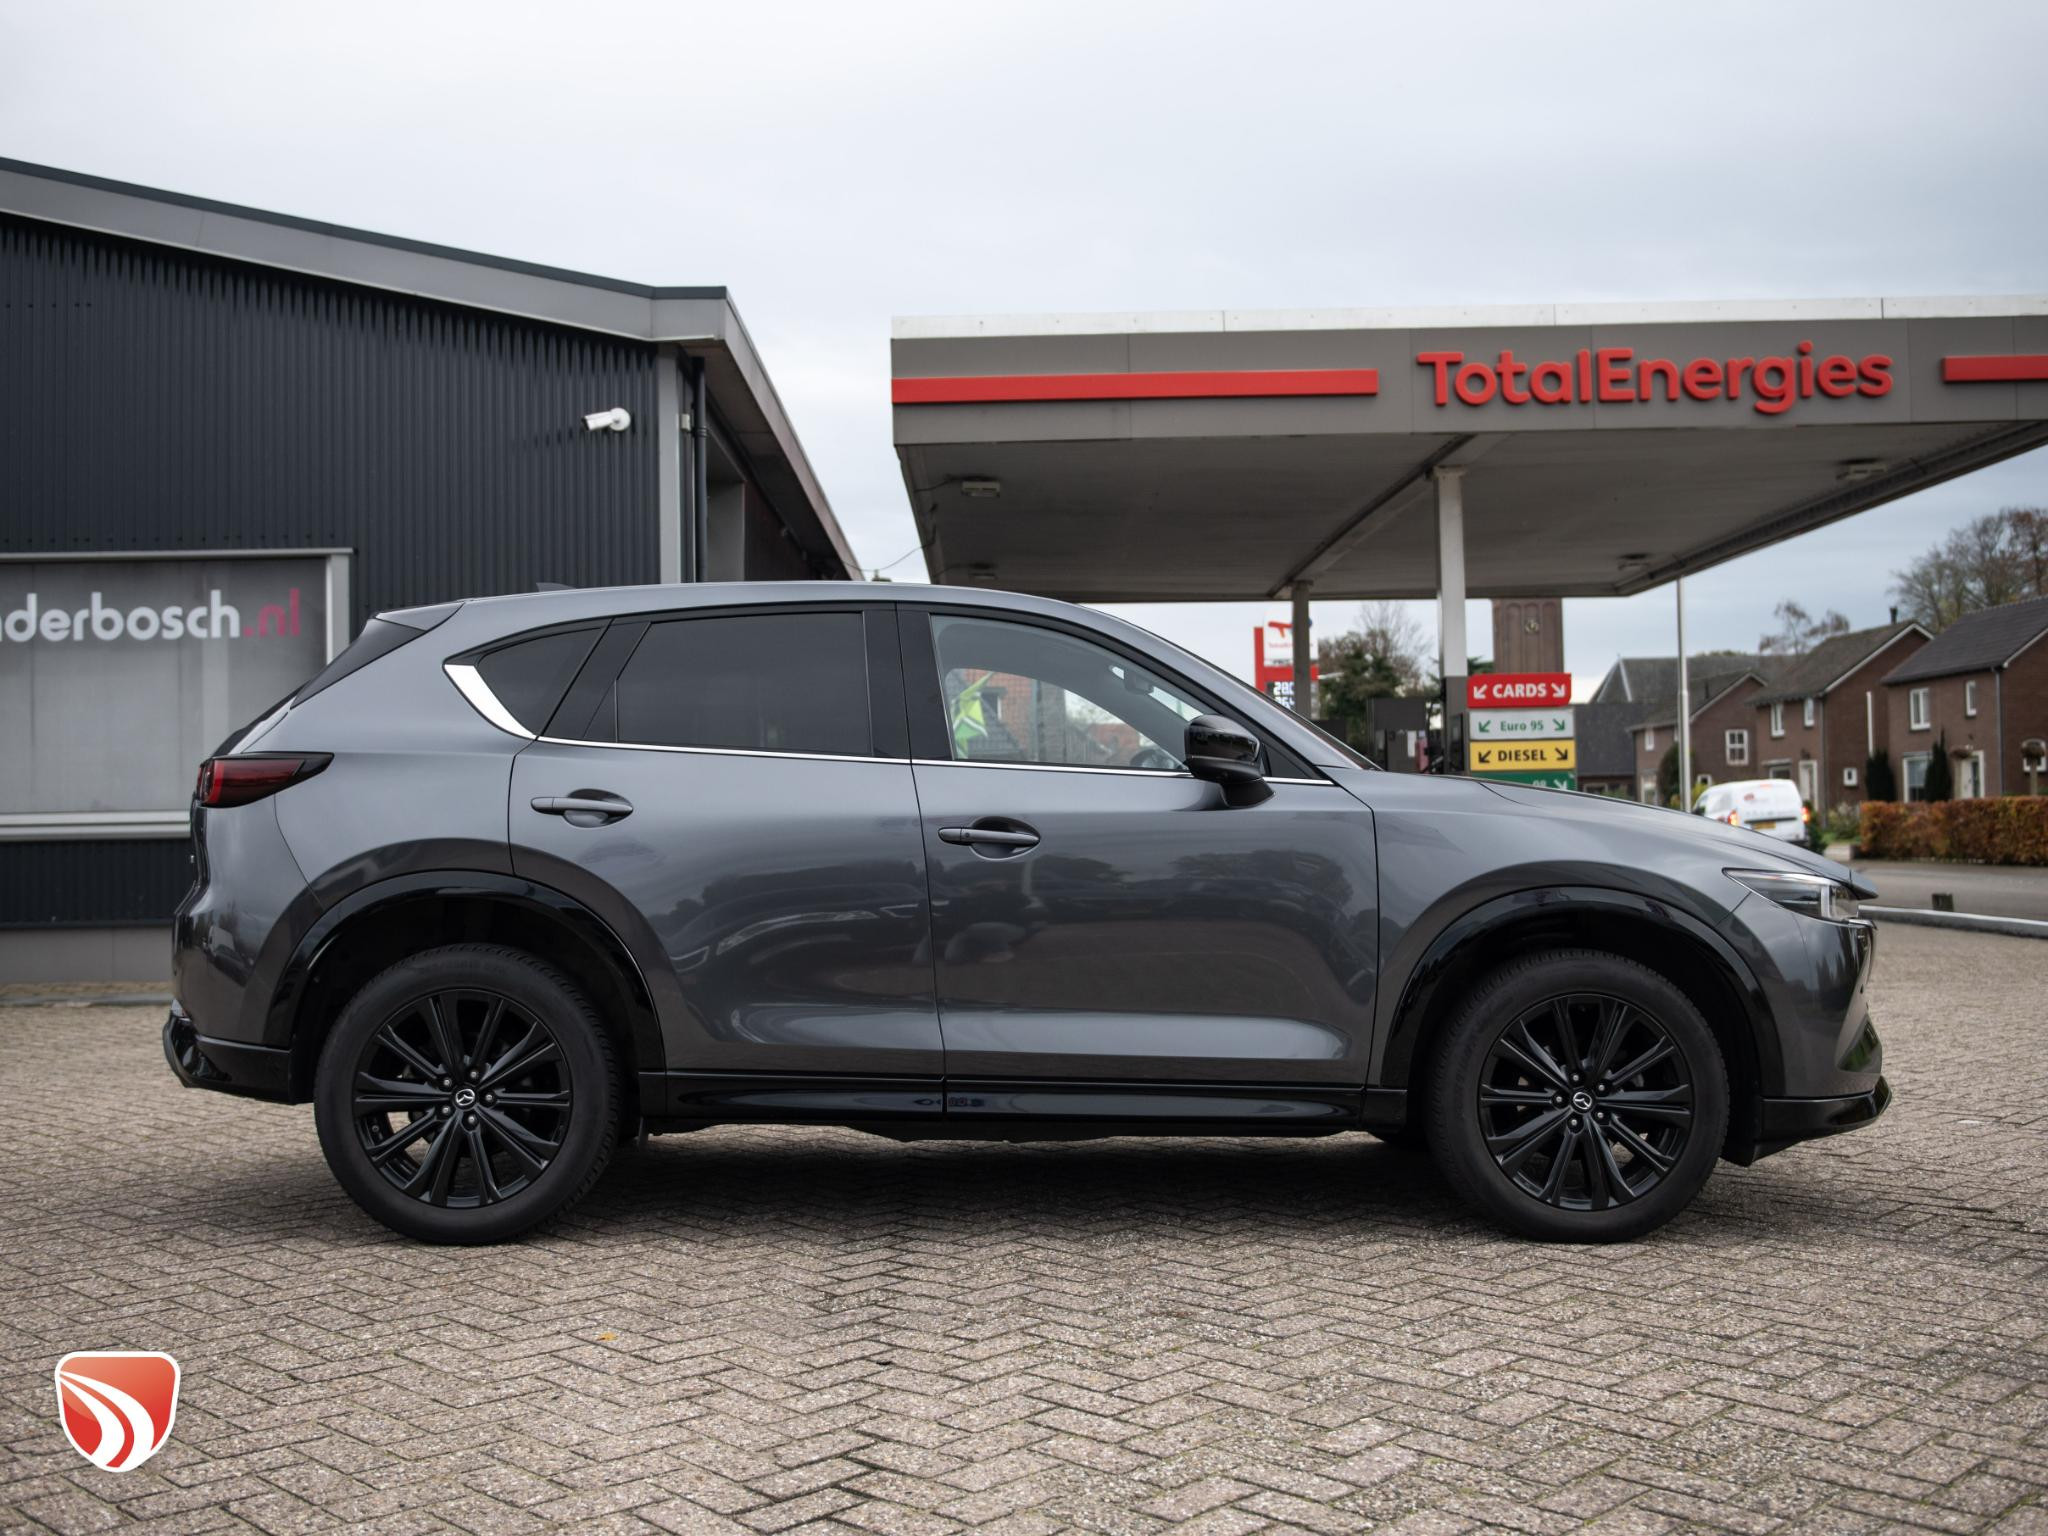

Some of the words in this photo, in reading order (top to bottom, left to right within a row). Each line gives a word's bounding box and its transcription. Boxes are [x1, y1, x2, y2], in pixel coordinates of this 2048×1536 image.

[1416, 341, 1894, 416] TotalEnergies
[0, 588, 300, 642] derbosch.nl
[1492, 683, 1547, 699] CARDS
[1500, 721, 1527, 732] Euro
[1530, 720, 1544, 731] 95
[1498, 749, 1547, 761] DIESEL
